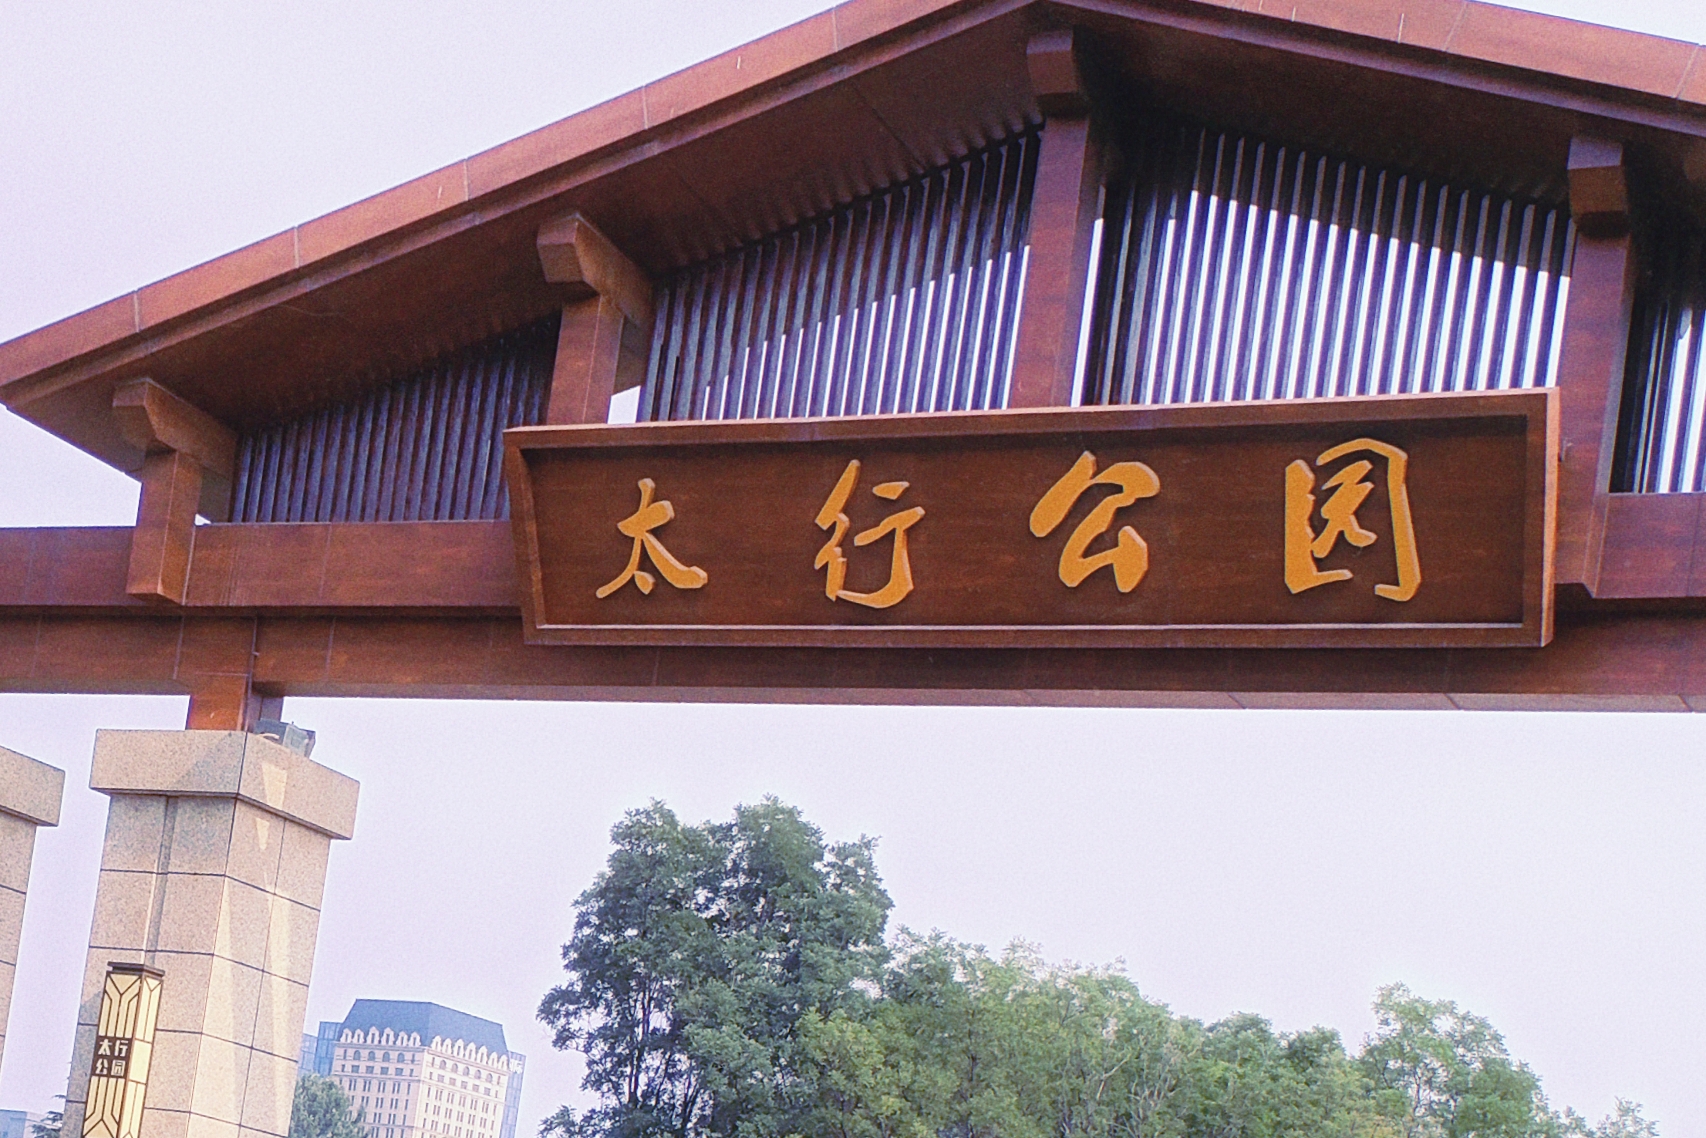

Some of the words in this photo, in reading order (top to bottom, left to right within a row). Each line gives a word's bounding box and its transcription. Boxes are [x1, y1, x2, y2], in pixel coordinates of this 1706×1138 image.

[595, 436, 1422, 609] 太行公园
[98, 1038, 129, 1057] 太行
[95, 1058, 126, 1077] 公园
